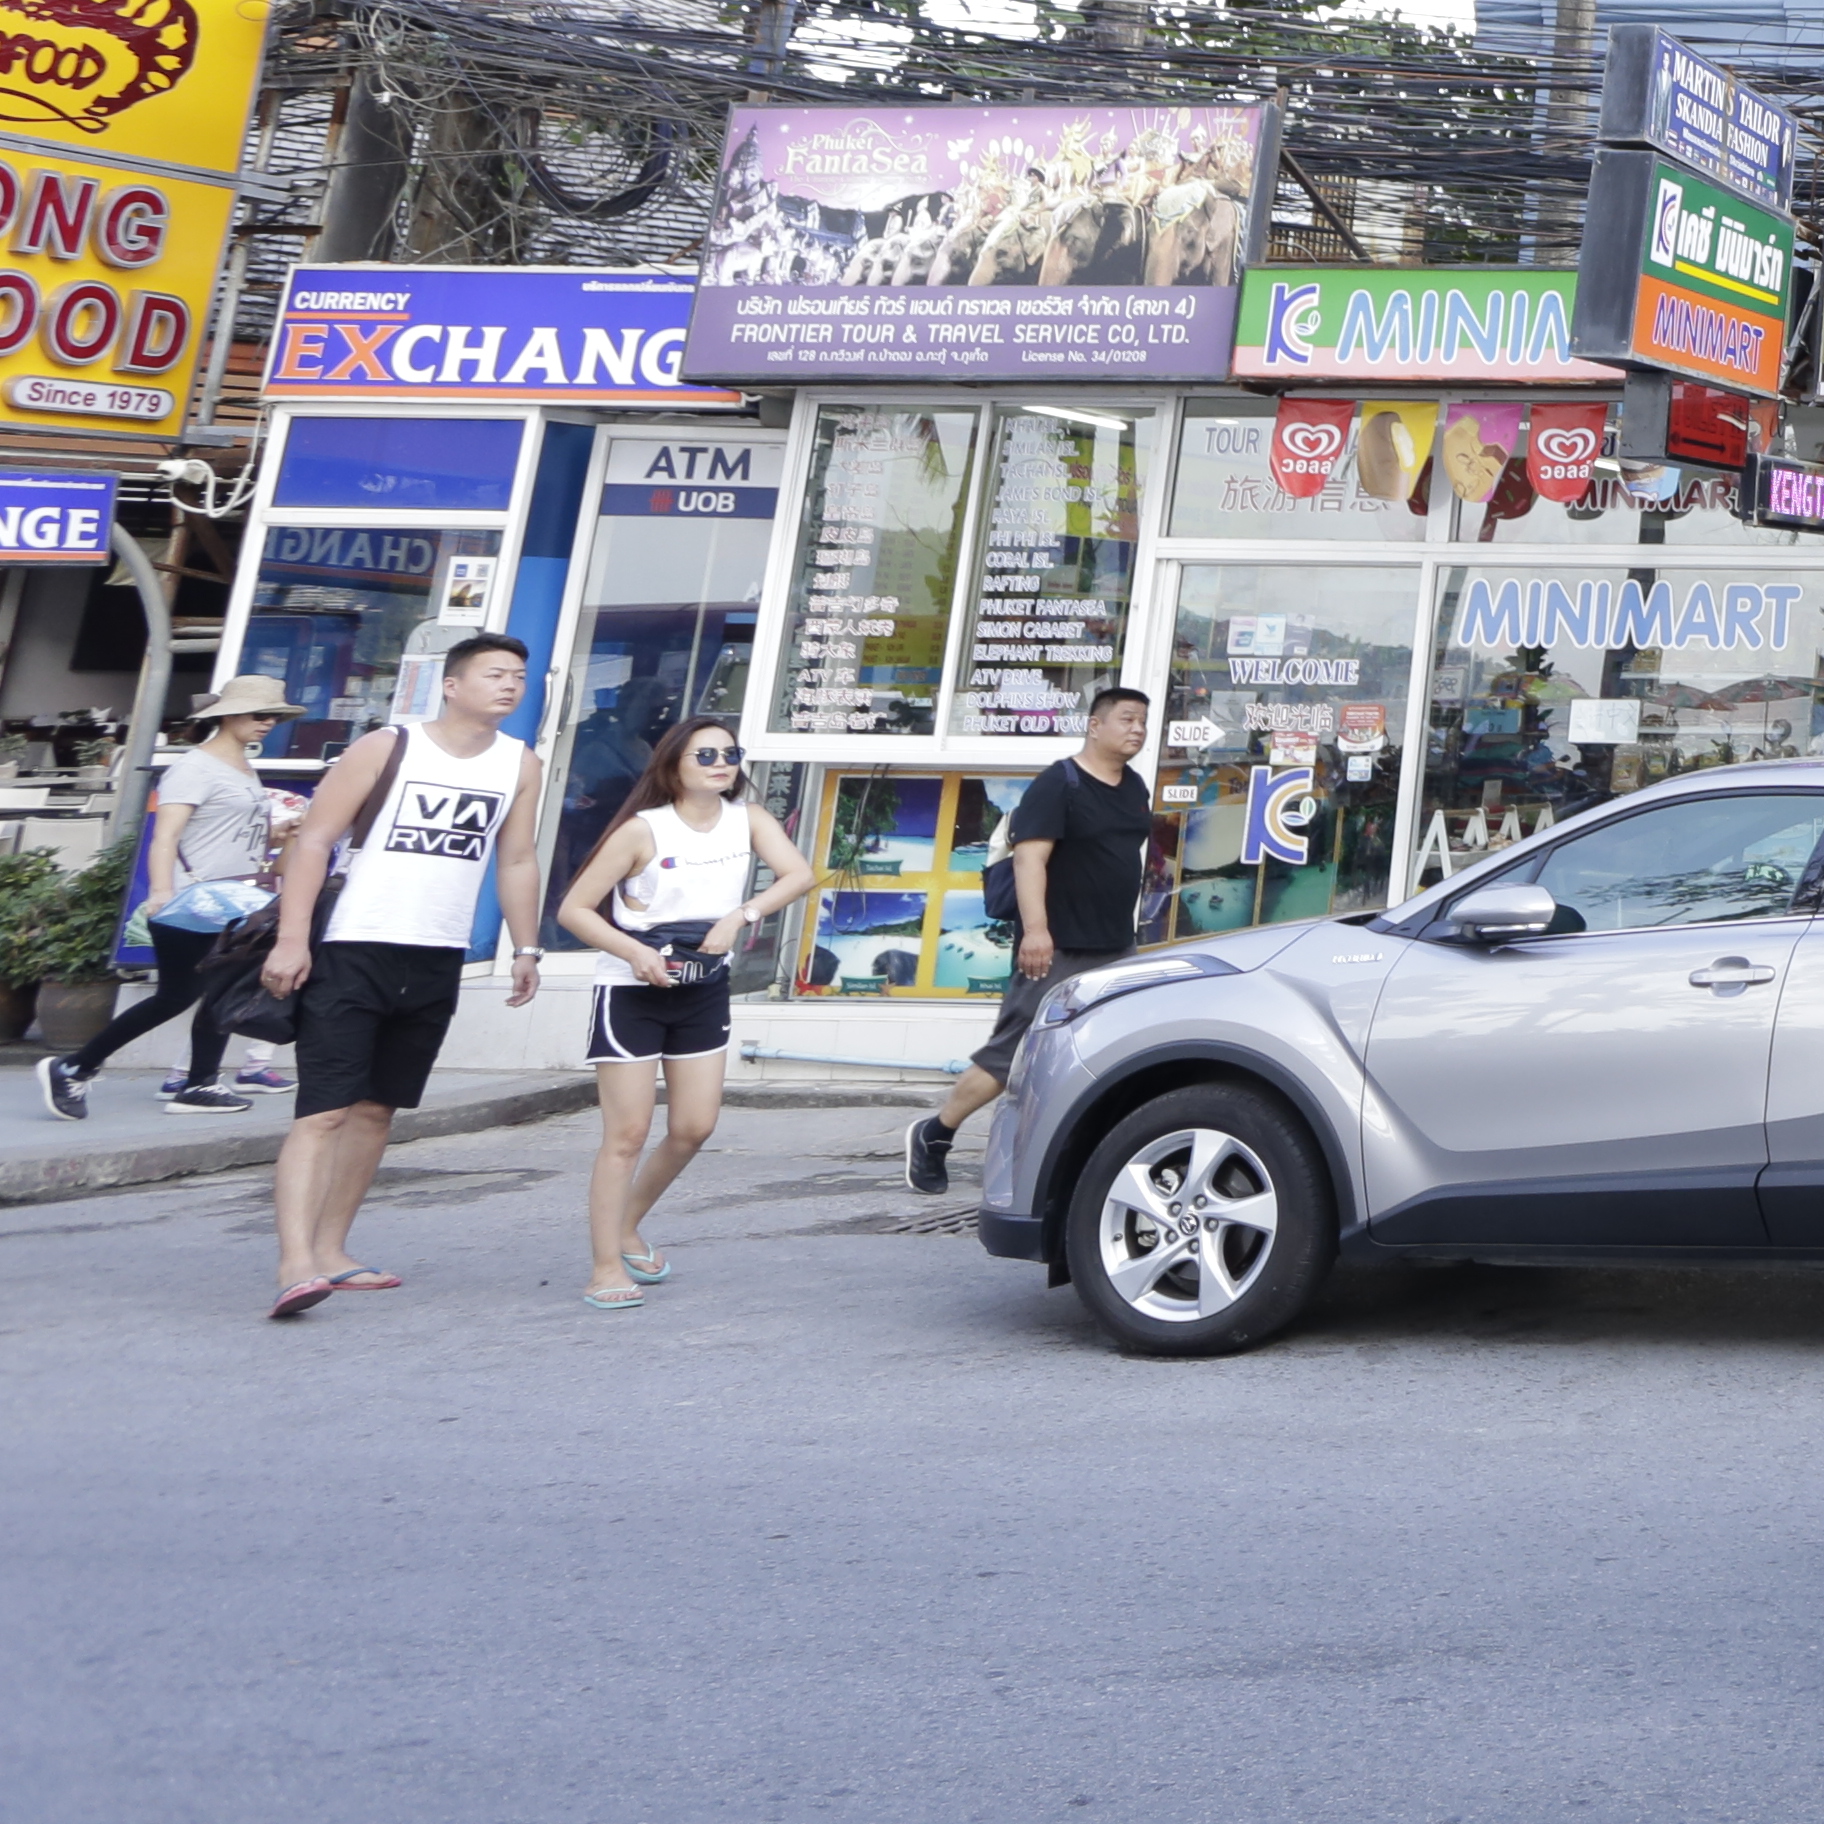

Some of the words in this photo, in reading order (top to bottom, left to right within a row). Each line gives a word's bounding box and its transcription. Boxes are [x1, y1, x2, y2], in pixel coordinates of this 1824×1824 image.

[1673, 50, 1735, 117] MARTIN'S
[1739, 93, 1780, 146] TAILOR
[1675, 92, 1723, 143] SKANDIA
[1726, 123, 1769, 168] FASHION
[812, 133, 873, 150] Phuket
[784, 147, 928, 175] FantaSea
[1677, 206, 1715, 264] เคซี
[1715, 217, 1783, 292] มินิมาร์ท
[294, 291, 410, 311] CURRENCY
[737, 295, 782, 315] บริษัท
[874, 295, 906, 315] ทัวร์
[910, 295, 953, 315] แอนด์
[957, 298, 1011, 315] ทราเวล
[1016, 295, 1073, 315] เซอร์วิส
[1078, 294, 1120, 315] จำกัด
[1174, 295, 1195, 319] 4)
[731, 324, 833, 343] FRONTIER
[841, 324, 895, 343] TOUR
[902, 324, 917, 343] &
[928, 324, 1004, 344] TRAVEL
[1013, 324, 1101, 344] SERVICE
[1108, 324, 1139, 346] CO,
[1148, 324, 1190, 344] LTD.
[1652, 293, 1764, 375] MINIMART
[797, 350, 816, 361] 128
[1022, 350, 1064, 363] License
[1068, 350, 1087, 363] No.
[27, 382, 96, 407] Since
[107, 390, 161, 413] 1979
[1205, 427, 1260, 454] TOUR
[645, 446, 751, 480] ATM
[1281, 456, 1336, 474] วอลล์
[1540, 460, 1598, 480] วอลล์
[677, 491, 735, 513] UOB
[992, 508, 1028, 524] RAYA
[989, 530, 1012, 547] PHI
[1013, 530, 1036, 547] PHI
[985, 551, 1029, 568] CORAL
[982, 575, 1040, 592] RAFTING
[979, 599, 1034, 616] PHUKET
[1035, 599, 1107, 616] FANTASEA
[1458, 579, 1803, 651] MINIMART
[976, 622, 1021, 639] SIMON
[1023, 622, 1086, 639] CABARET
[973, 644, 1043, 662] ELEPHANT
[1045, 645, 1113, 662] TREKKING
[970, 668, 1000, 686] ATV
[1002, 669, 1043, 686] DRIVE
[1228, 658, 1359, 686] WELCOME
[966, 691, 1033, 709] DOLPHINS
[1036, 692, 1081, 709] SHOW
[963, 716, 1018, 733] PHUKET
[1020, 716, 1051, 733] OLD
[1243, 703, 1334, 732] 欢迎光临
[1173, 726, 1210, 741] SLIDE
[1167, 788, 1195, 799] SLIDE
[388, 827, 487, 860] RVCA
